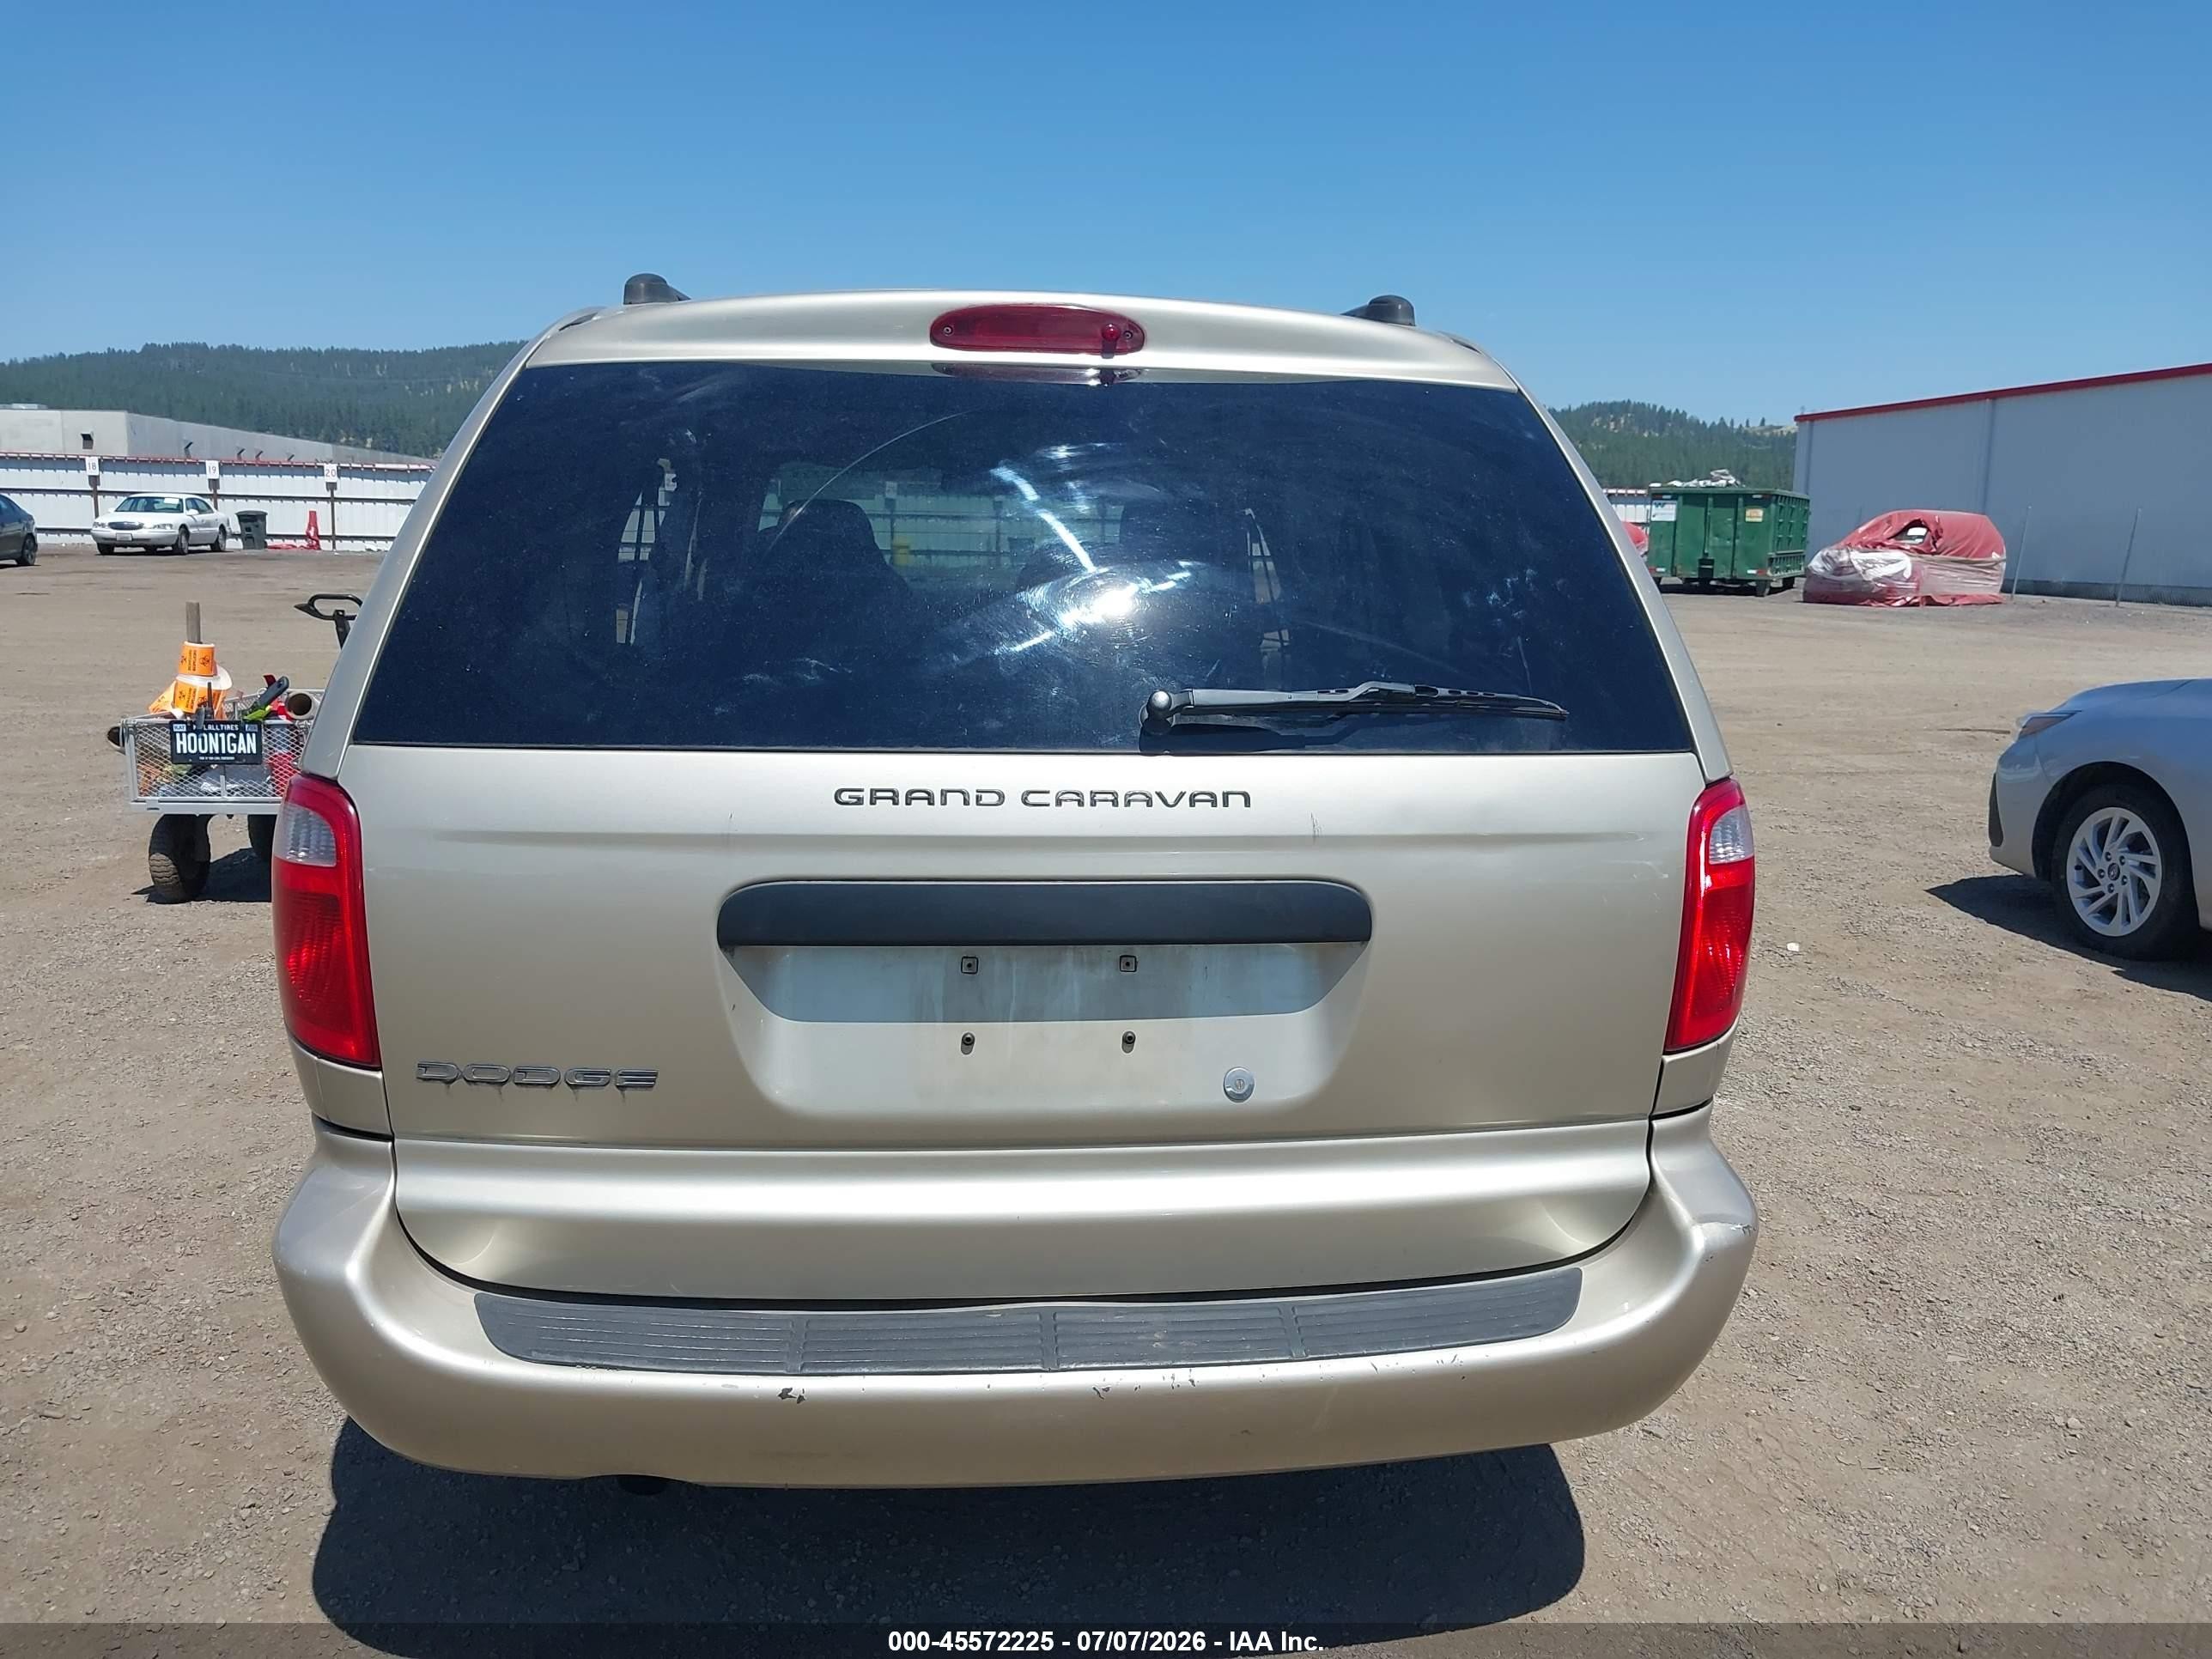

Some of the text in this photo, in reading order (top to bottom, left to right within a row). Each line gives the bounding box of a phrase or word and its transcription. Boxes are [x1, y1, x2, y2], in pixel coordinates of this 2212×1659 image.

[88, 461, 97, 471] 18
[209, 465, 216, 474] 19
[325, 468, 337, 477] 20
[834, 787, 1251, 808] GRAND CARAVAN
[416, 1061, 659, 1088] DODGE
